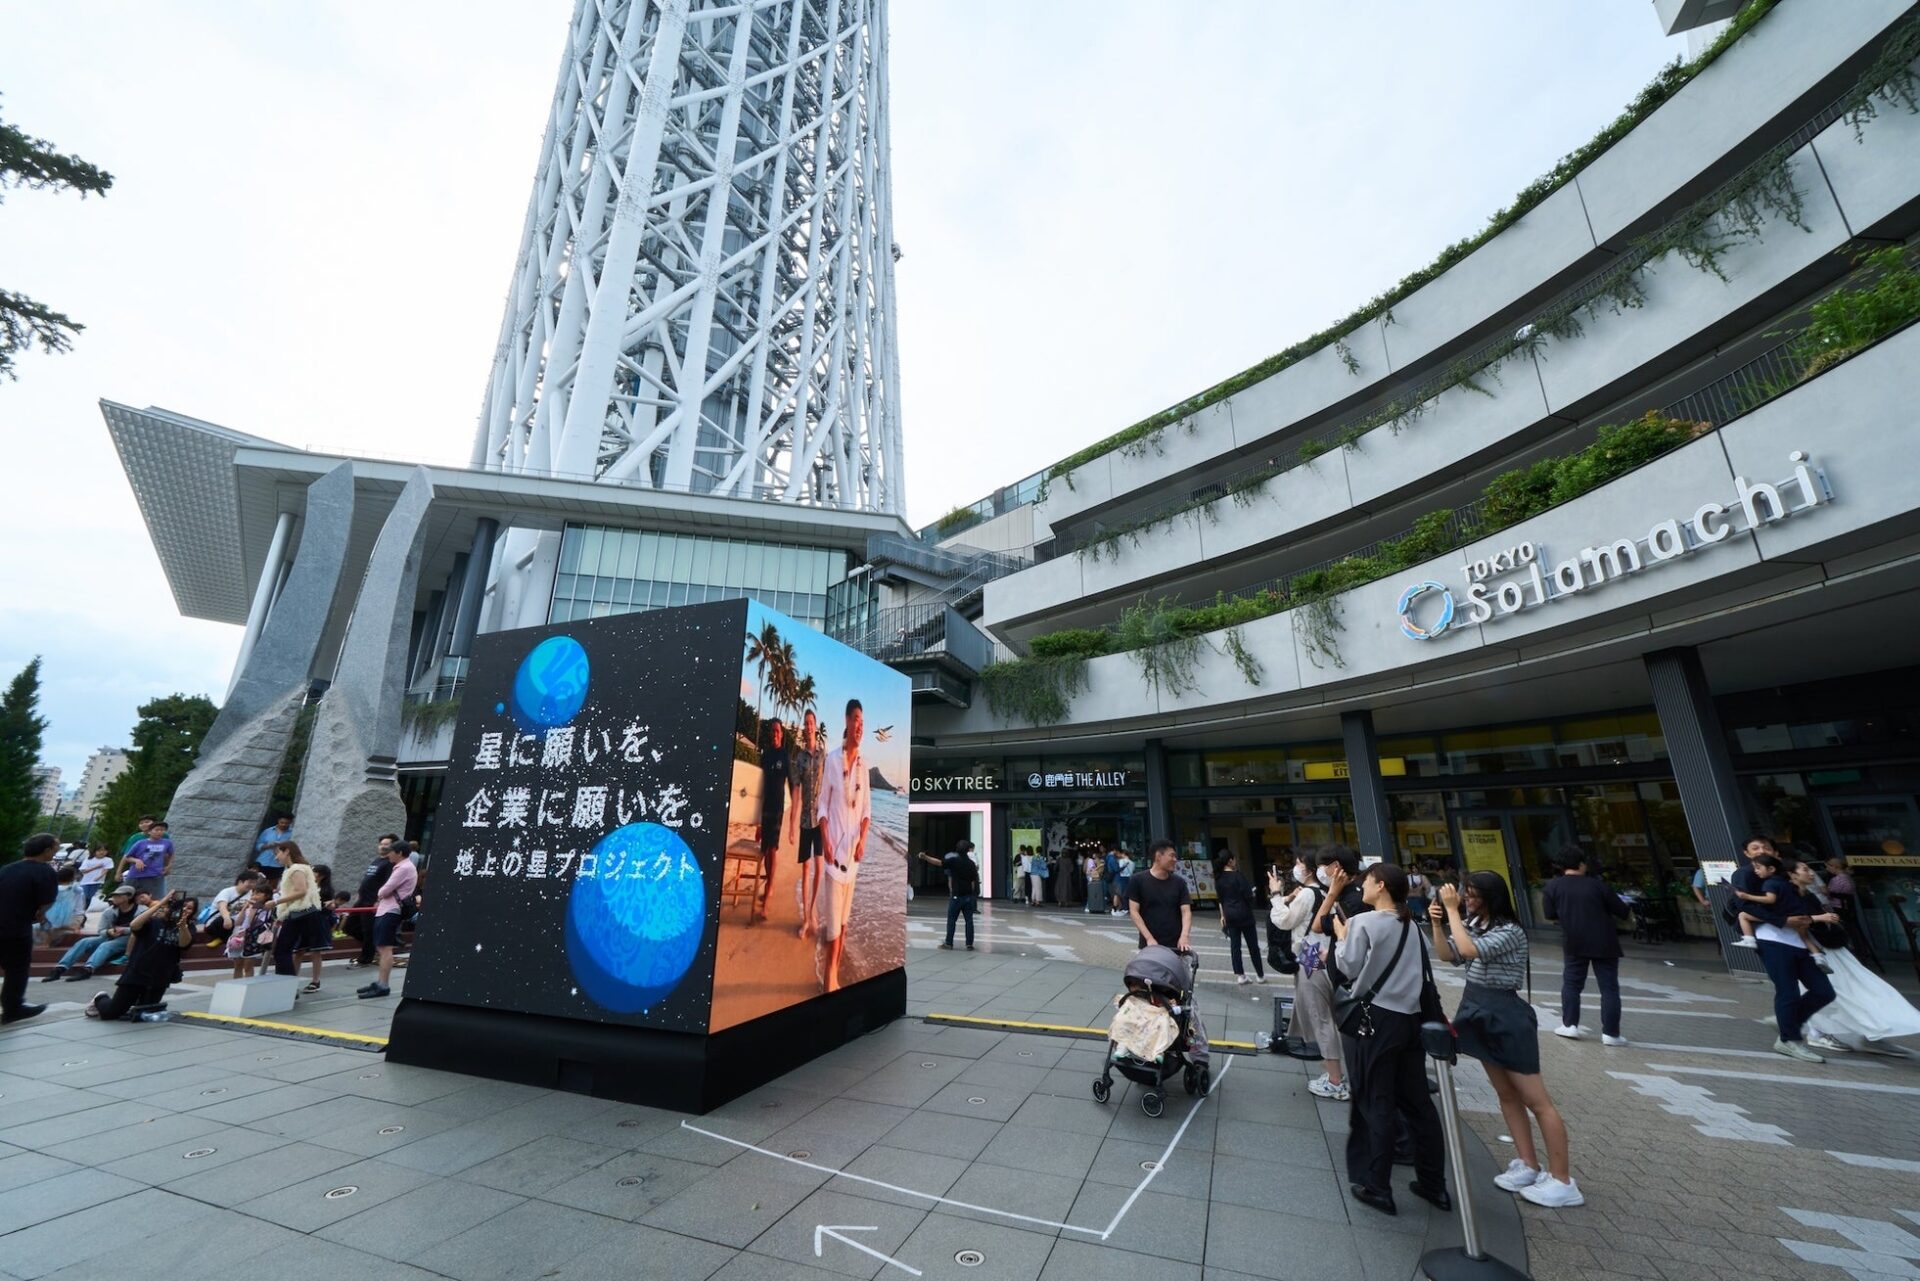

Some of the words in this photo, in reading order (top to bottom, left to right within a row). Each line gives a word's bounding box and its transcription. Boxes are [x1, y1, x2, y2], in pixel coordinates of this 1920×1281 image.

[1465, 451, 1822, 624] Solamachi
[1460, 541, 1536, 583] TOKYO
[473, 724, 664, 771] 星に願いを、
[1075, 772, 1094, 787] THE
[1095, 771, 1126, 787] ALLEY
[462, 783, 704, 828] 企業に願いを。
[453, 848, 695, 880] 地上の星プロジェクト
[1852, 857, 1886, 865] PENNY
